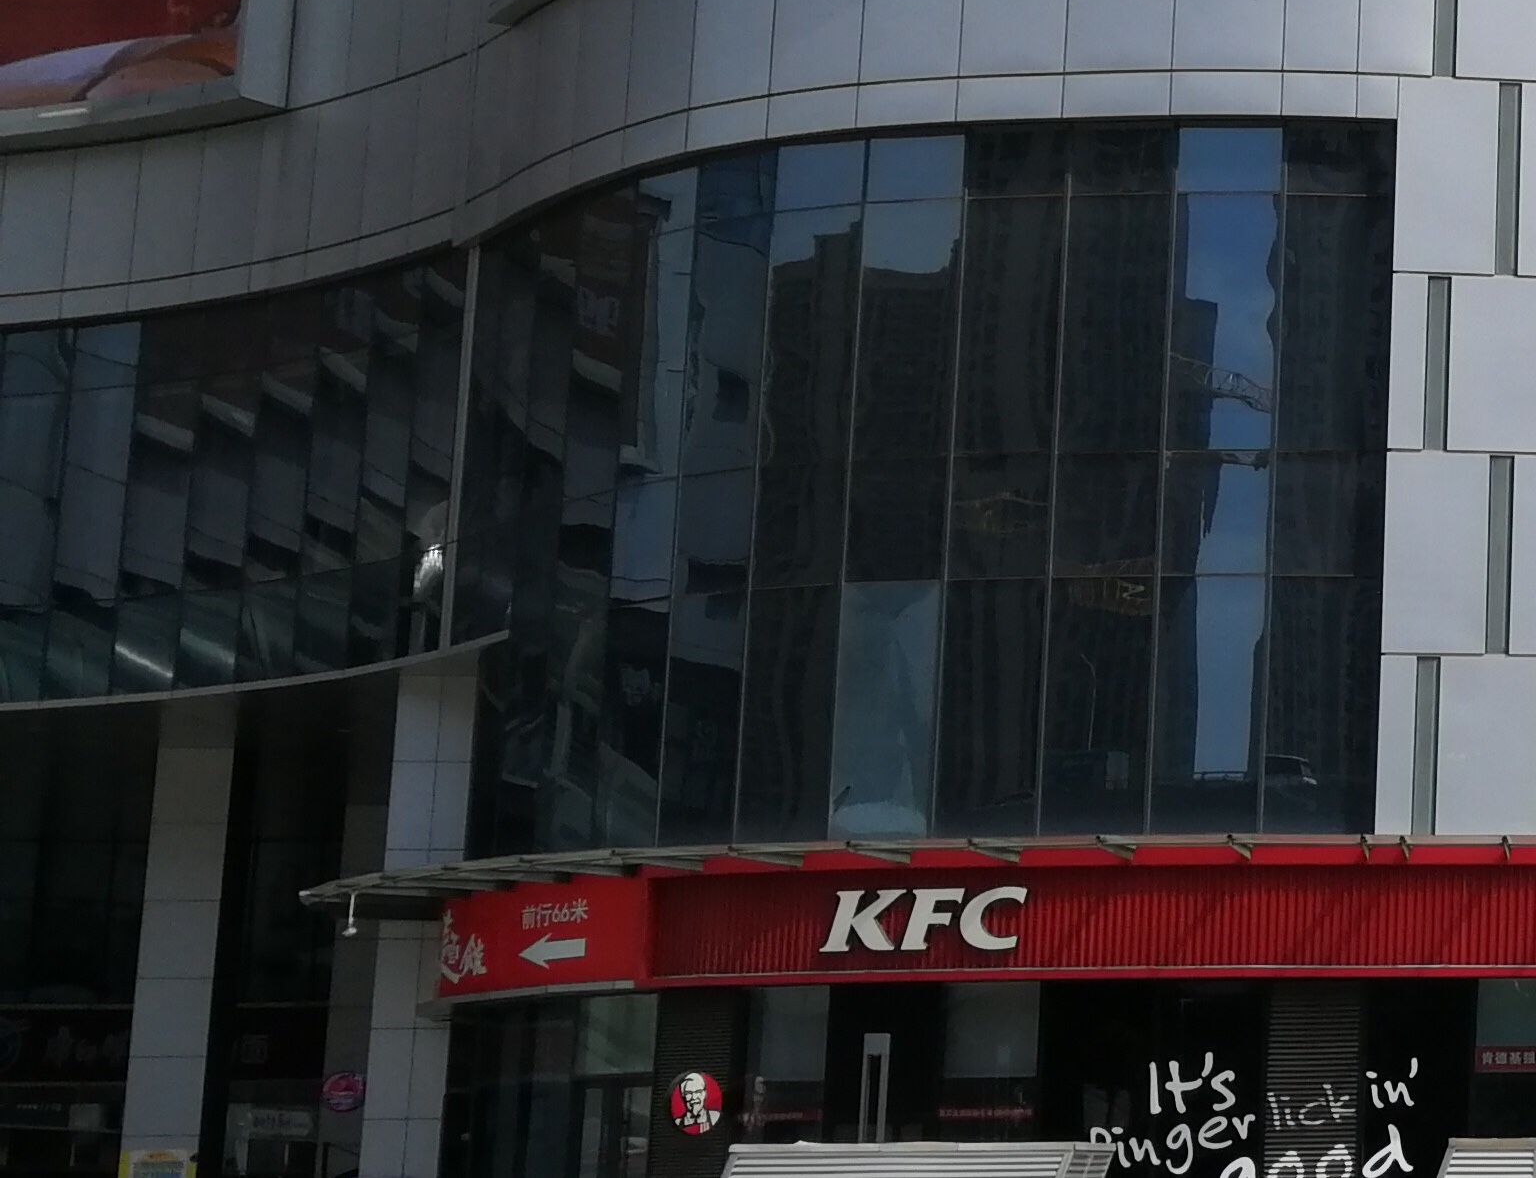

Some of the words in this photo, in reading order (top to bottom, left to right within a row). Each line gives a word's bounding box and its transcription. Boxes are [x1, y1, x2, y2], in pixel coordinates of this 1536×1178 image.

[521, 897, 589, 930] 前行66米
[819, 885, 1028, 953] KFC
[1149, 1051, 1236, 1115] It's
[1089, 1113, 1256, 1175] inger
